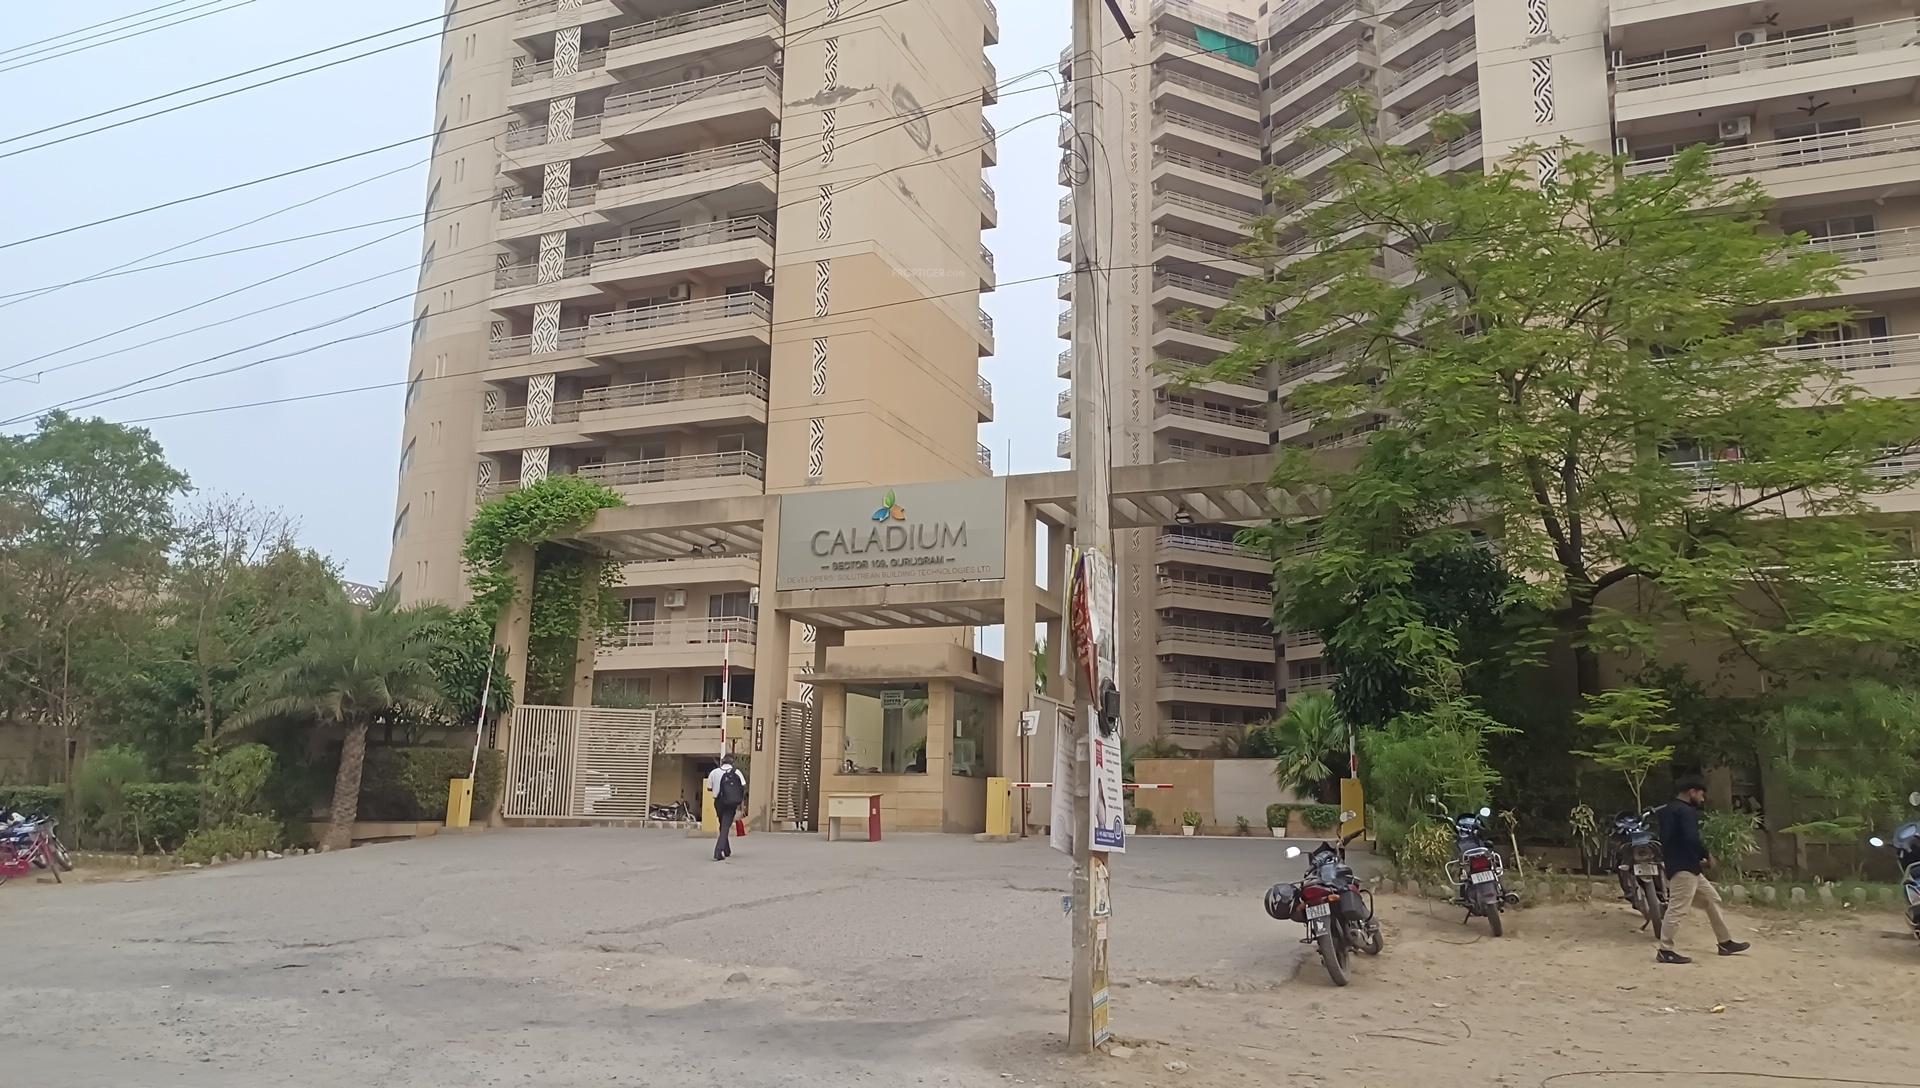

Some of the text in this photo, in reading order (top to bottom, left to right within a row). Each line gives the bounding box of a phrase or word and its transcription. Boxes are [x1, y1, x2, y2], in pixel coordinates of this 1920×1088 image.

[810, 520, 968, 557] CALADIUM
[832, 560, 869, 571] SECTOR
[890, 556, 944, 567] GURUGRAM
